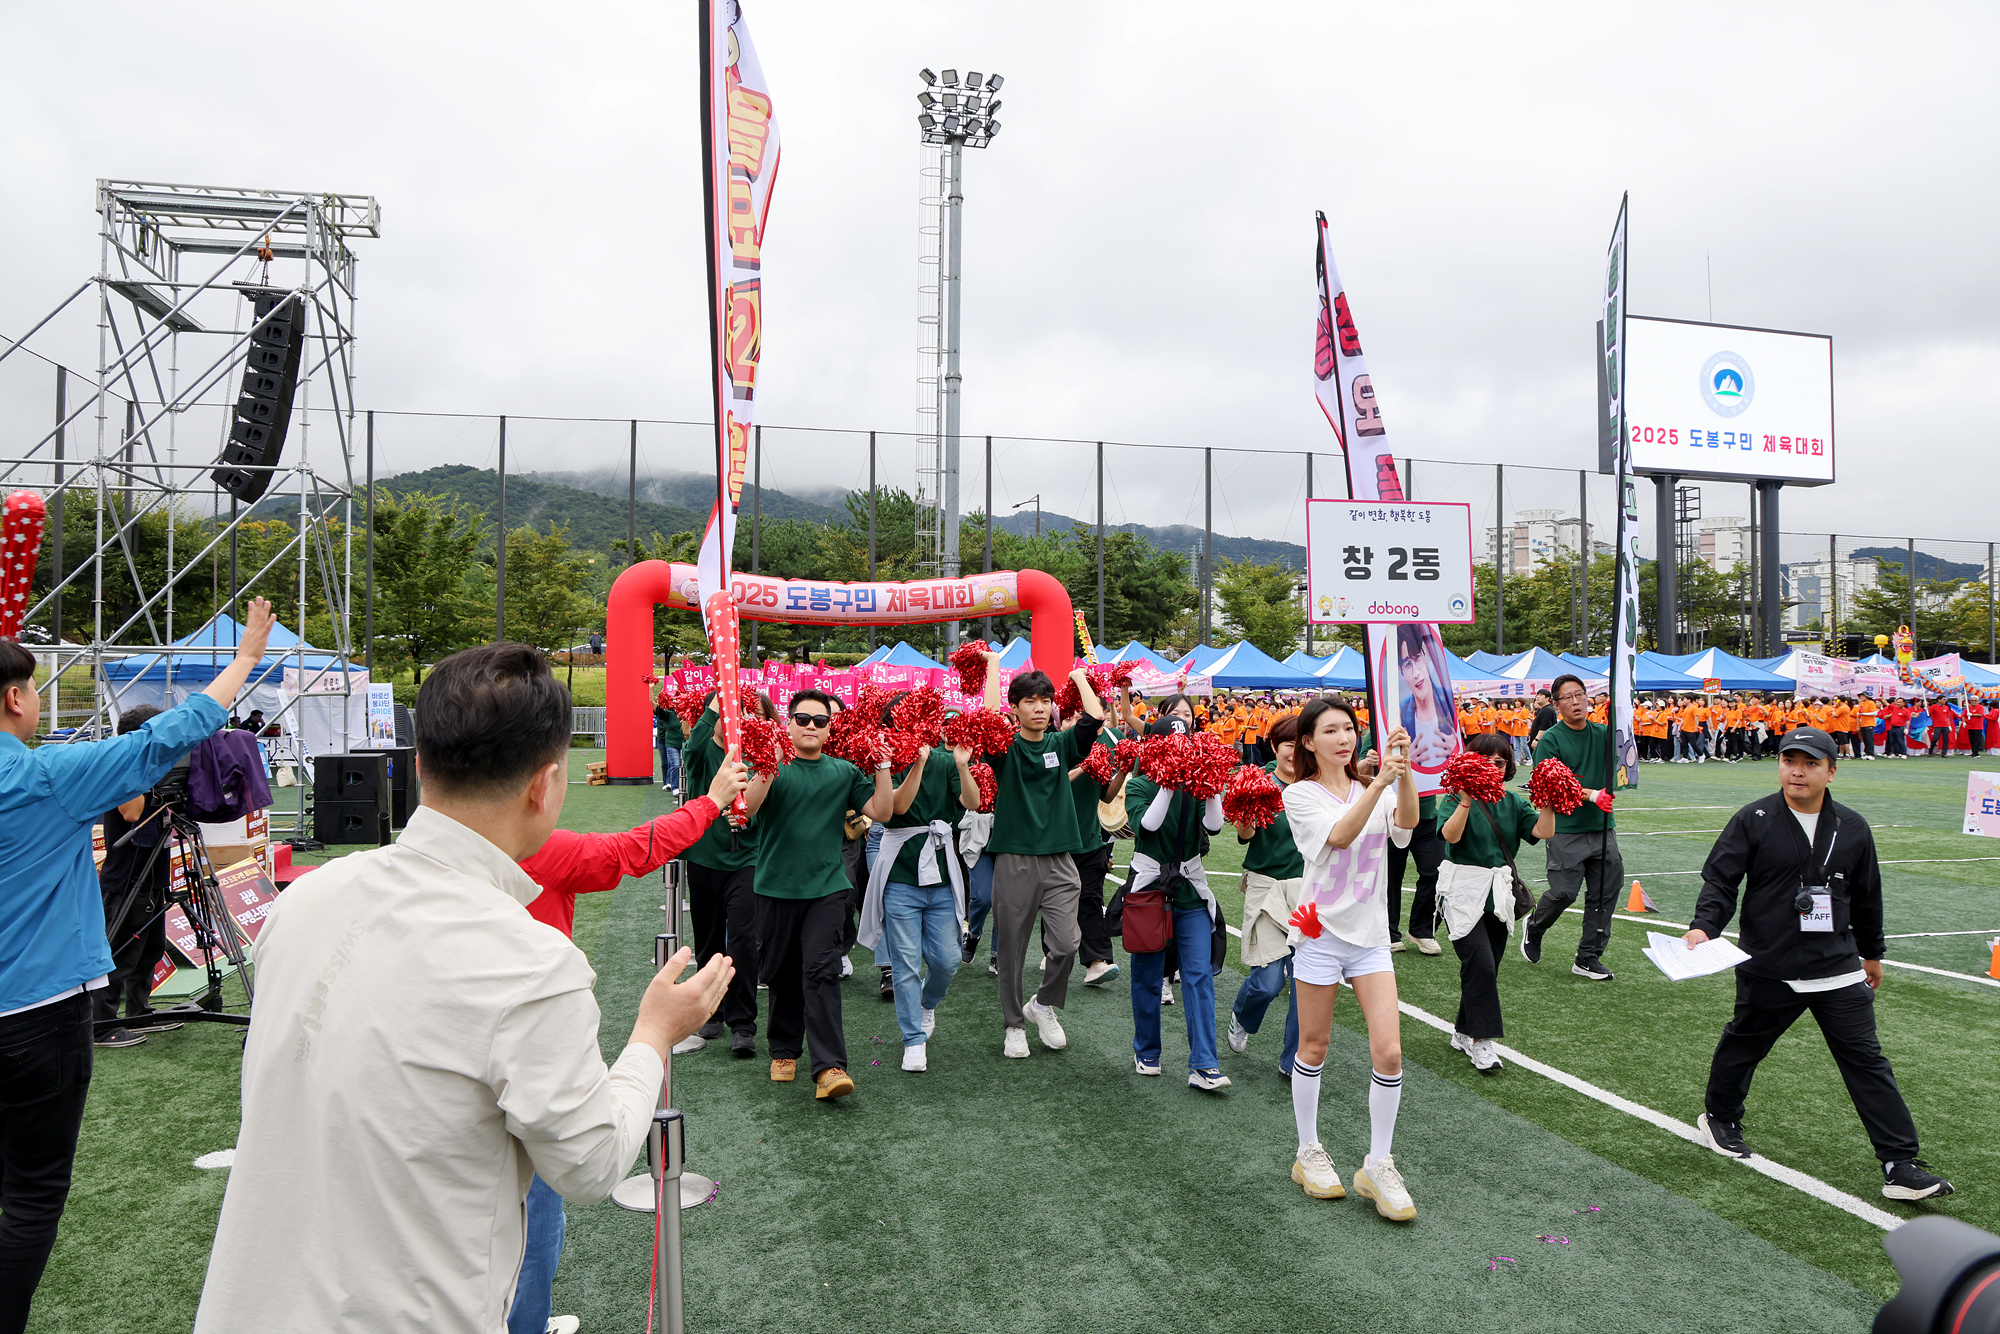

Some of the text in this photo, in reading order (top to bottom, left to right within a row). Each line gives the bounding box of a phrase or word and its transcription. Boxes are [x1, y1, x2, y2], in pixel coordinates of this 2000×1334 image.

[1631, 425, 1824, 456] 2025 도봉구민 체육대회
[1349, 509, 1366, 521] 같이
[1389, 508, 1416, 523] 행복한
[1418, 509, 1432, 524] 도봉
[1342, 545, 1441, 581] 창 2동
[732, 580, 975, 613] 025 도봉구민 체육대회
[1368, 601, 1419, 617] dobong
[684, 669, 704, 685] 같이
[371, 692, 390, 700] 바로선
[372, 700, 390, 708] 봉사단
[965, 696, 985, 711] 창2
[1313, 833, 1387, 905] 35
[238, 888, 260, 906] 삼성
[1802, 913, 1831, 921] STAFF
